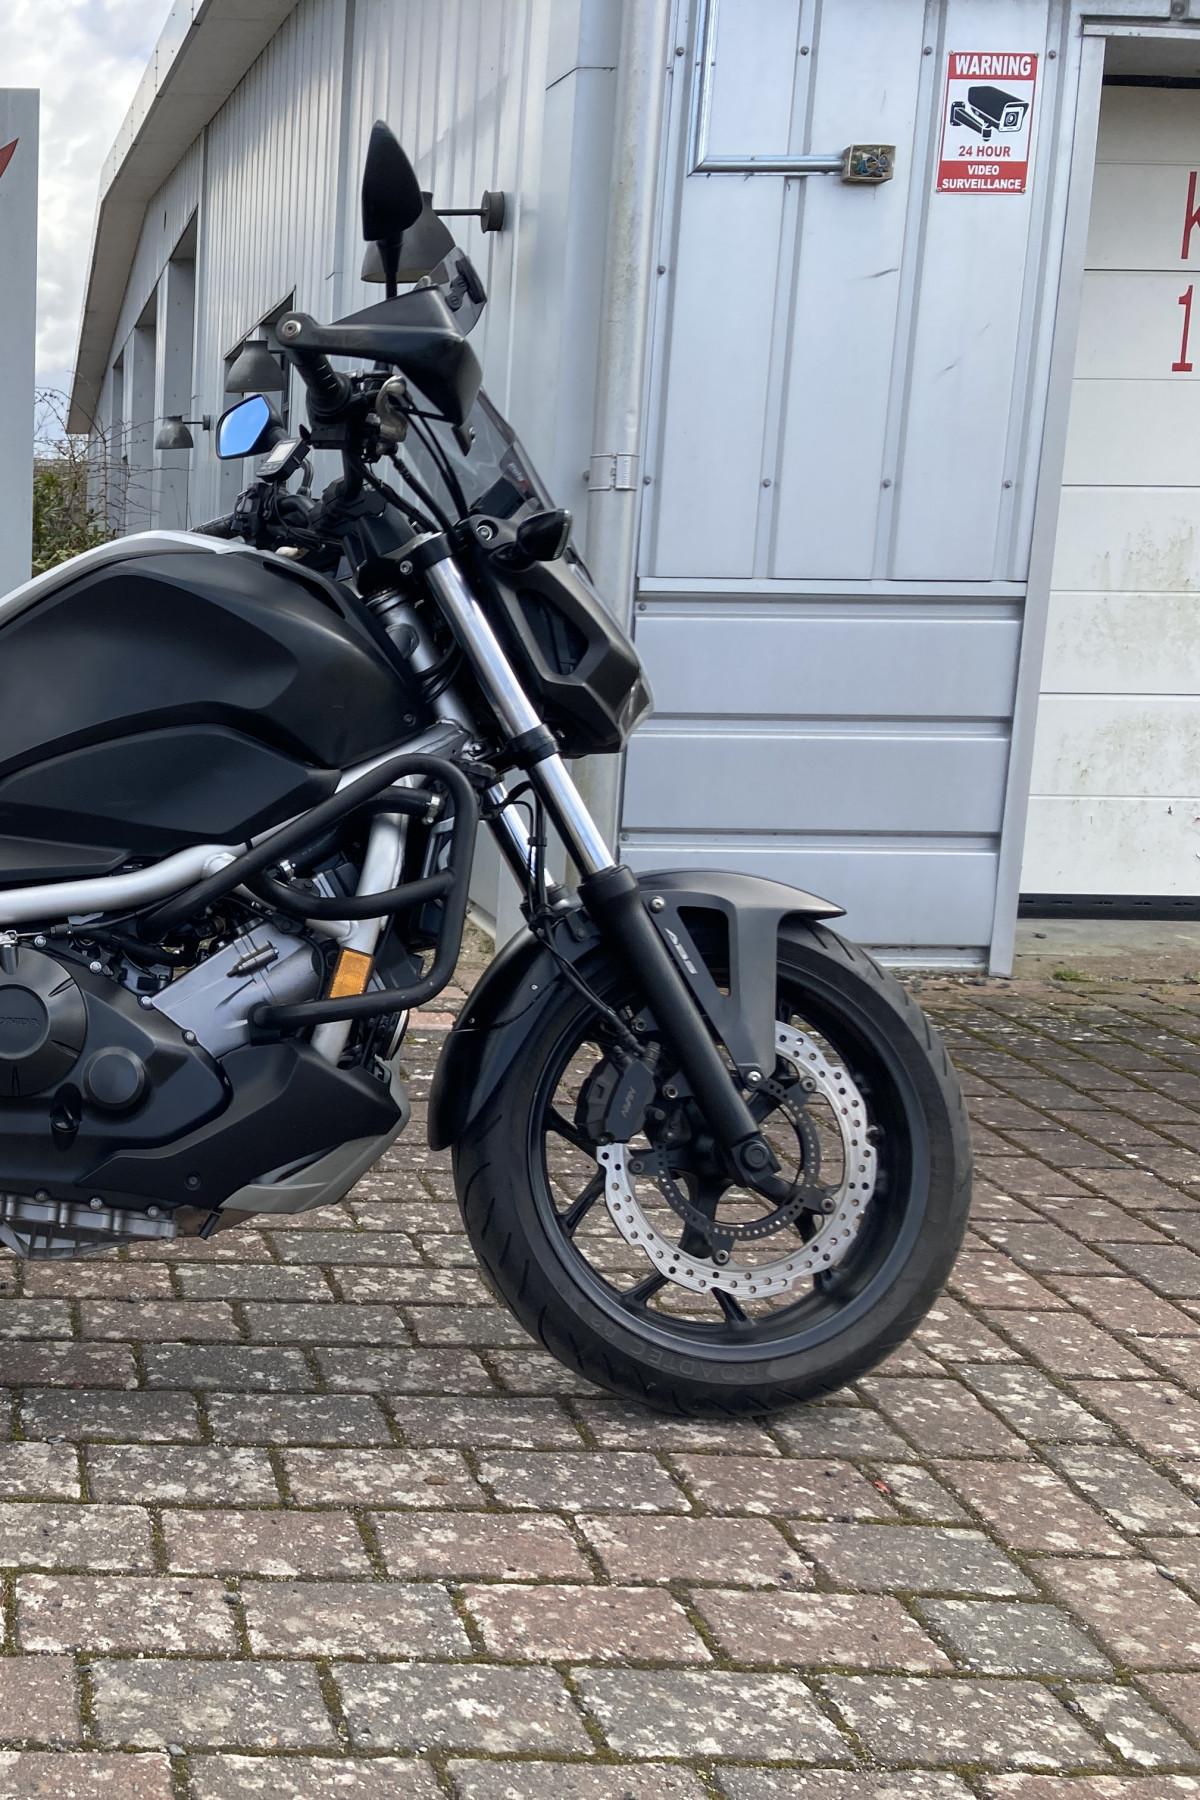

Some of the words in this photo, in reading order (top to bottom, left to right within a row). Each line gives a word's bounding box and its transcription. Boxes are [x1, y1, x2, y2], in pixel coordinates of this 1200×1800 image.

[955, 55, 1032, 76] WARNING
[958, 145, 973, 157] 24
[976, 146, 1011, 157] HOUR
[967, 164, 1000, 176] VIDEO
[941, 178, 1022, 190] SURVEILLANCE
[631, 1342, 760, 1382] ROADTEC
